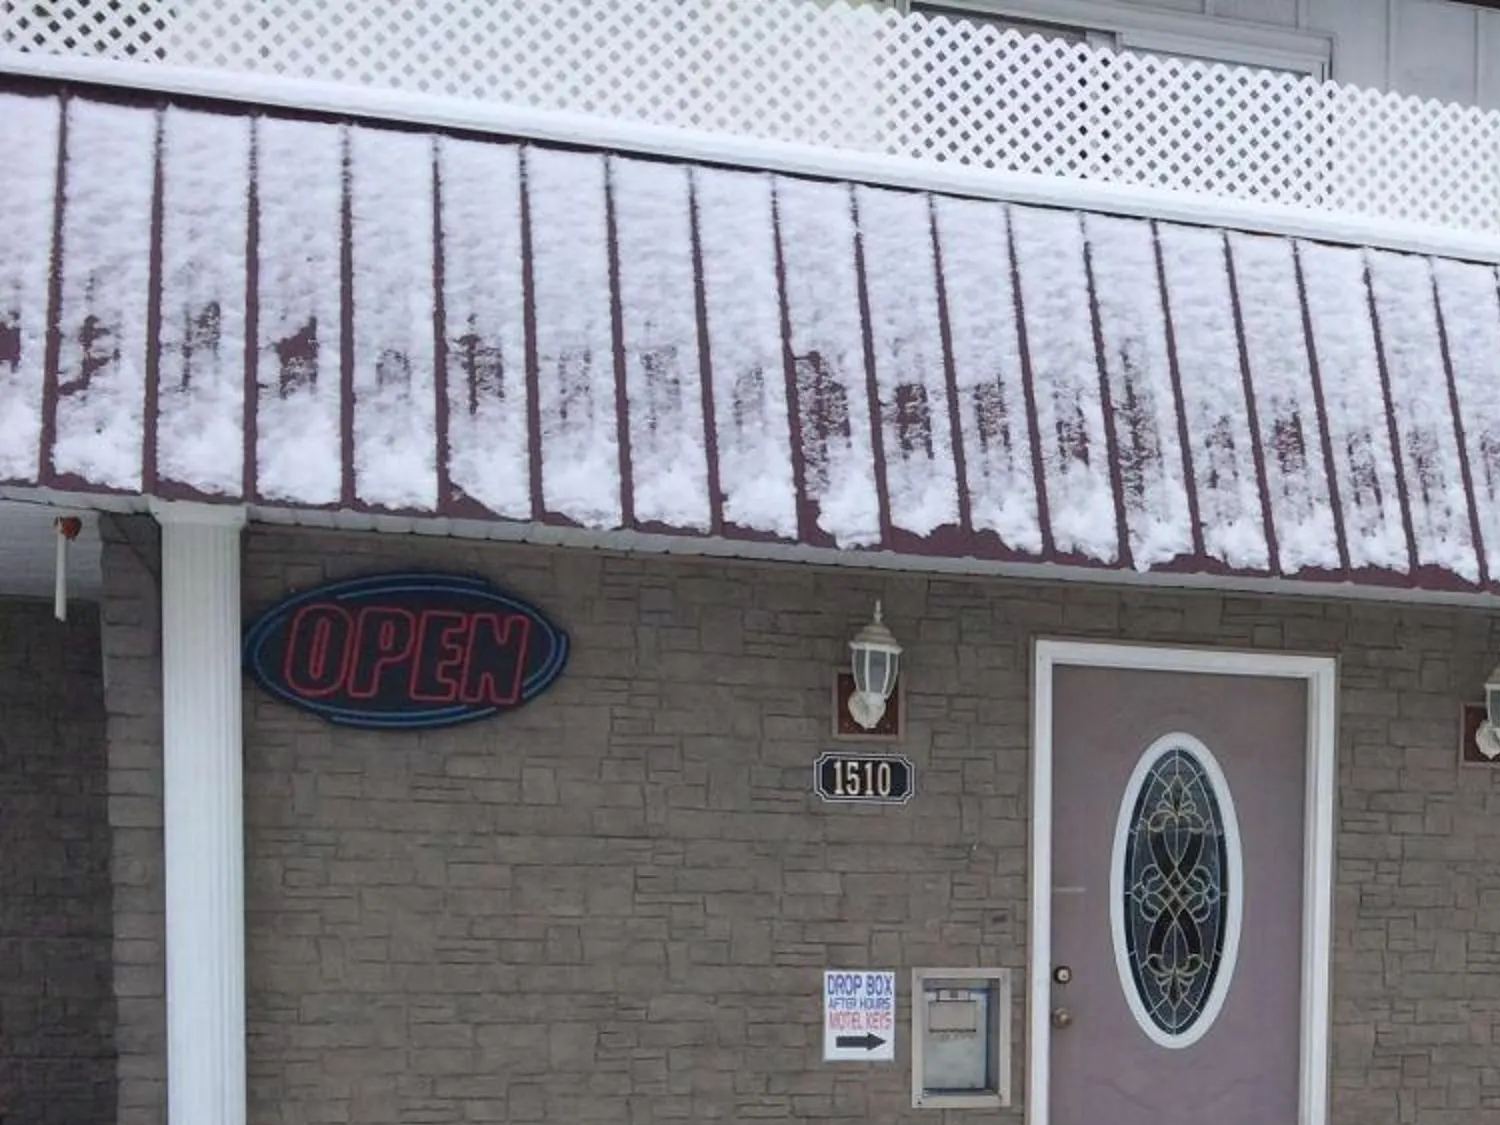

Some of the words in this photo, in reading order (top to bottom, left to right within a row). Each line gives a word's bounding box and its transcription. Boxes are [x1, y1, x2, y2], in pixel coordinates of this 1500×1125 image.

[284, 603, 531, 705] OPEN
[833, 760, 892, 795] 1510
[828, 974, 862, 995] DROP
[866, 974, 893, 996] BOX
[828, 997, 857, 1010] AFTER
[860, 997, 891, 1010] HOURS
[829, 1011, 863, 1029] MOTEL
[865, 1011, 892, 1029] KEYS
